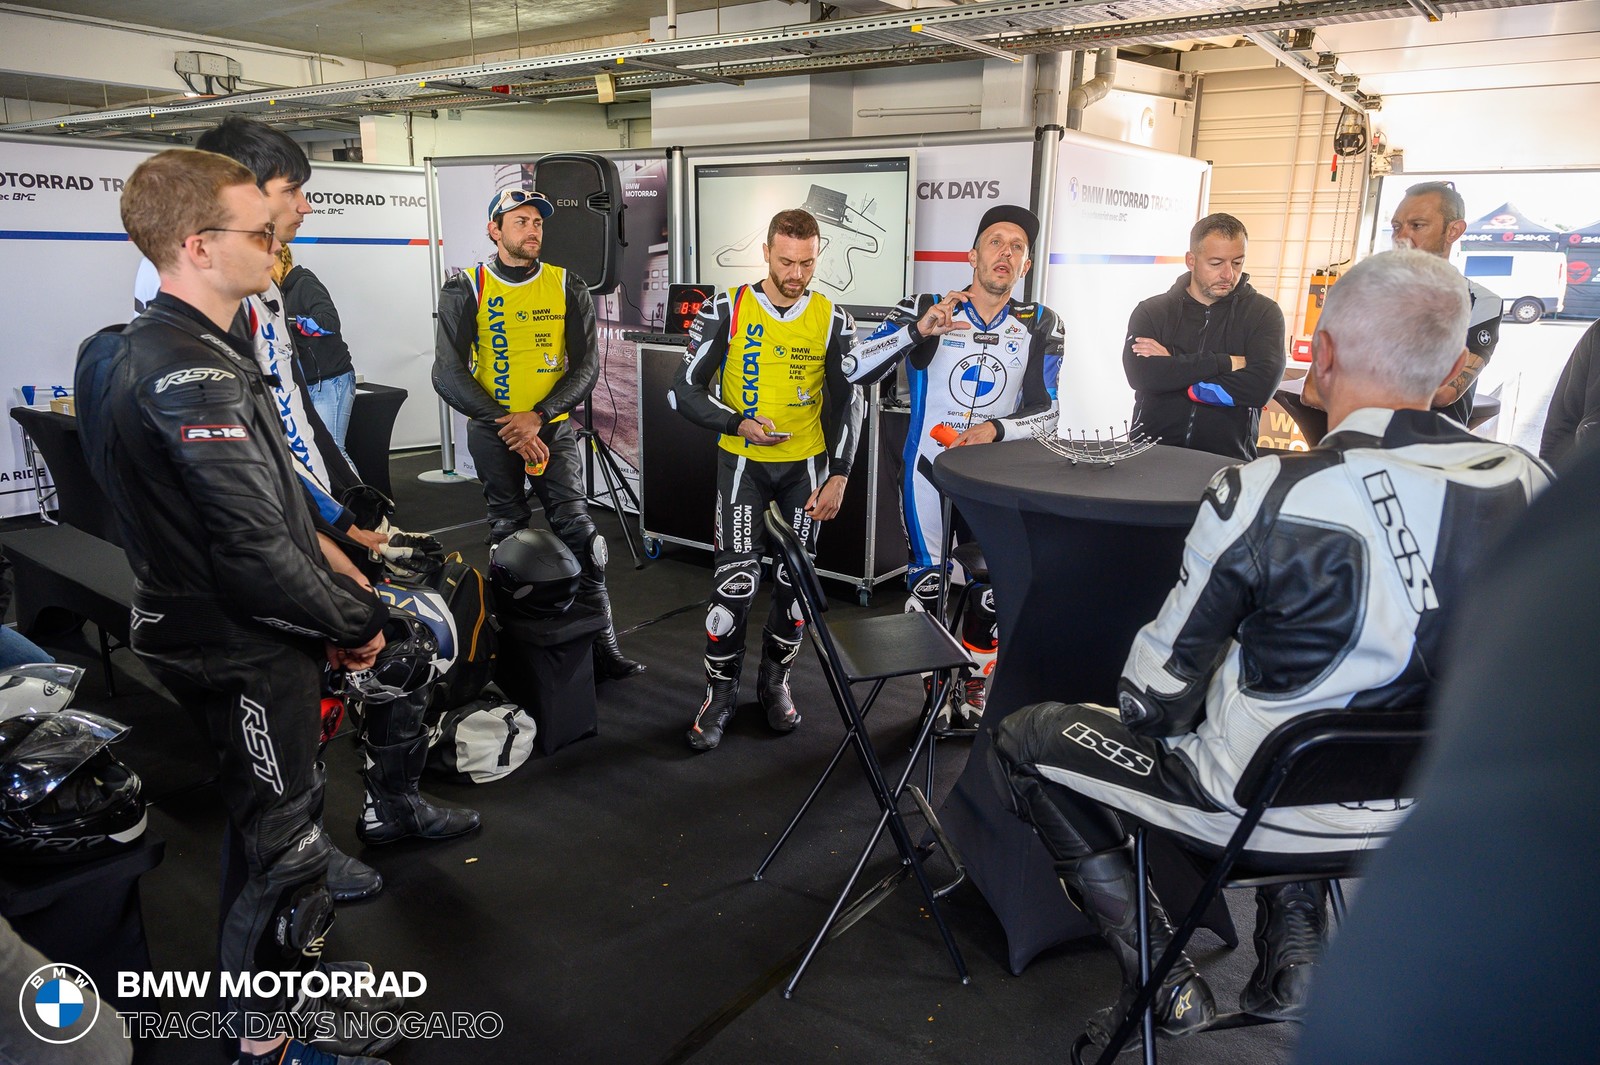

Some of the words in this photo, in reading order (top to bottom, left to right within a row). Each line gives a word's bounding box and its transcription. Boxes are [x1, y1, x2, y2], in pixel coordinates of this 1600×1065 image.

[947, 180, 1000, 200] DAYS
[1081, 184, 1105, 204] BMW
[1105, 189, 1149, 210] MOTORRAD
[556, 199, 578, 207] EON
[1514, 234, 1551, 242] 24MX
[532, 308, 551, 316] BMW
[154, 367, 236, 394] RST
[187, 427, 246, 439] R-16
[744, 505, 752, 536] MOTO
[240, 694, 284, 797] RST
